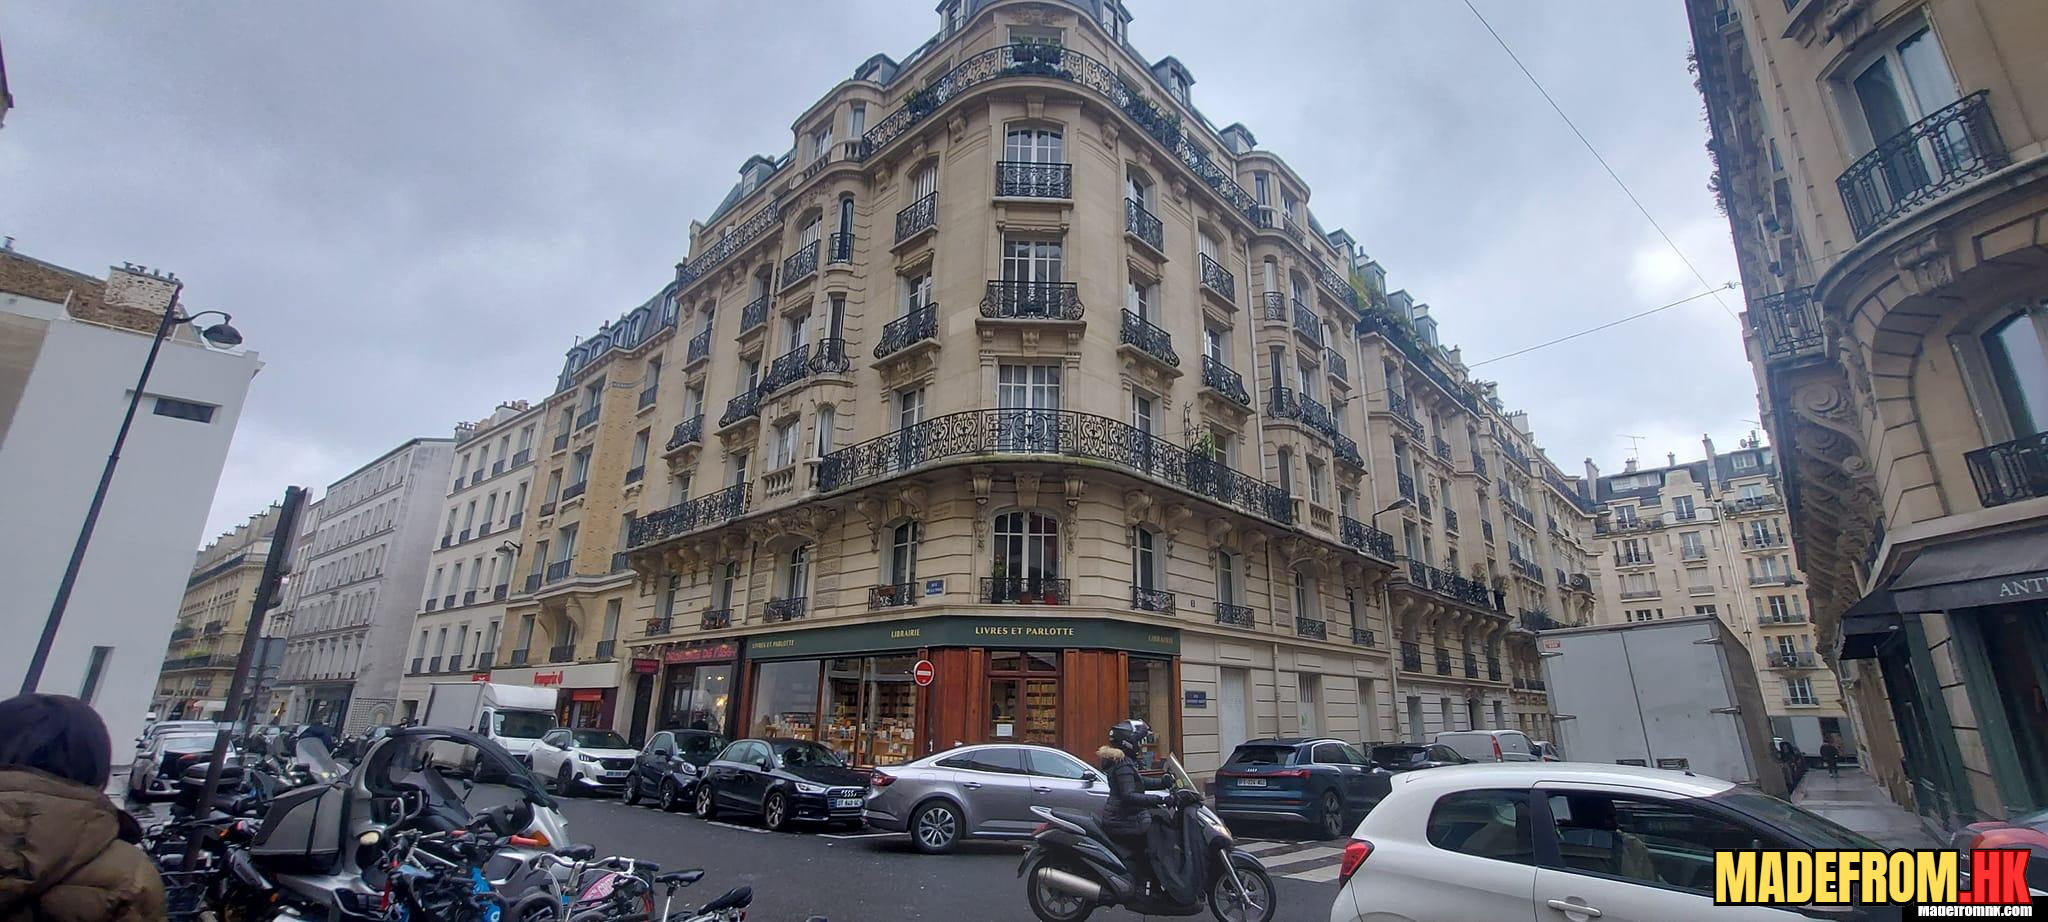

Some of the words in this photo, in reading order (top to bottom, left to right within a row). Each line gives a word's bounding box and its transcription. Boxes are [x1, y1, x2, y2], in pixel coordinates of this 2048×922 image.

[891, 628, 920, 638] LIBRAIRIE
[975, 626, 1008, 635] LIVRES
[1011, 627, 1022, 635] ET
[1026, 627, 1075, 636] PARLOTTE
